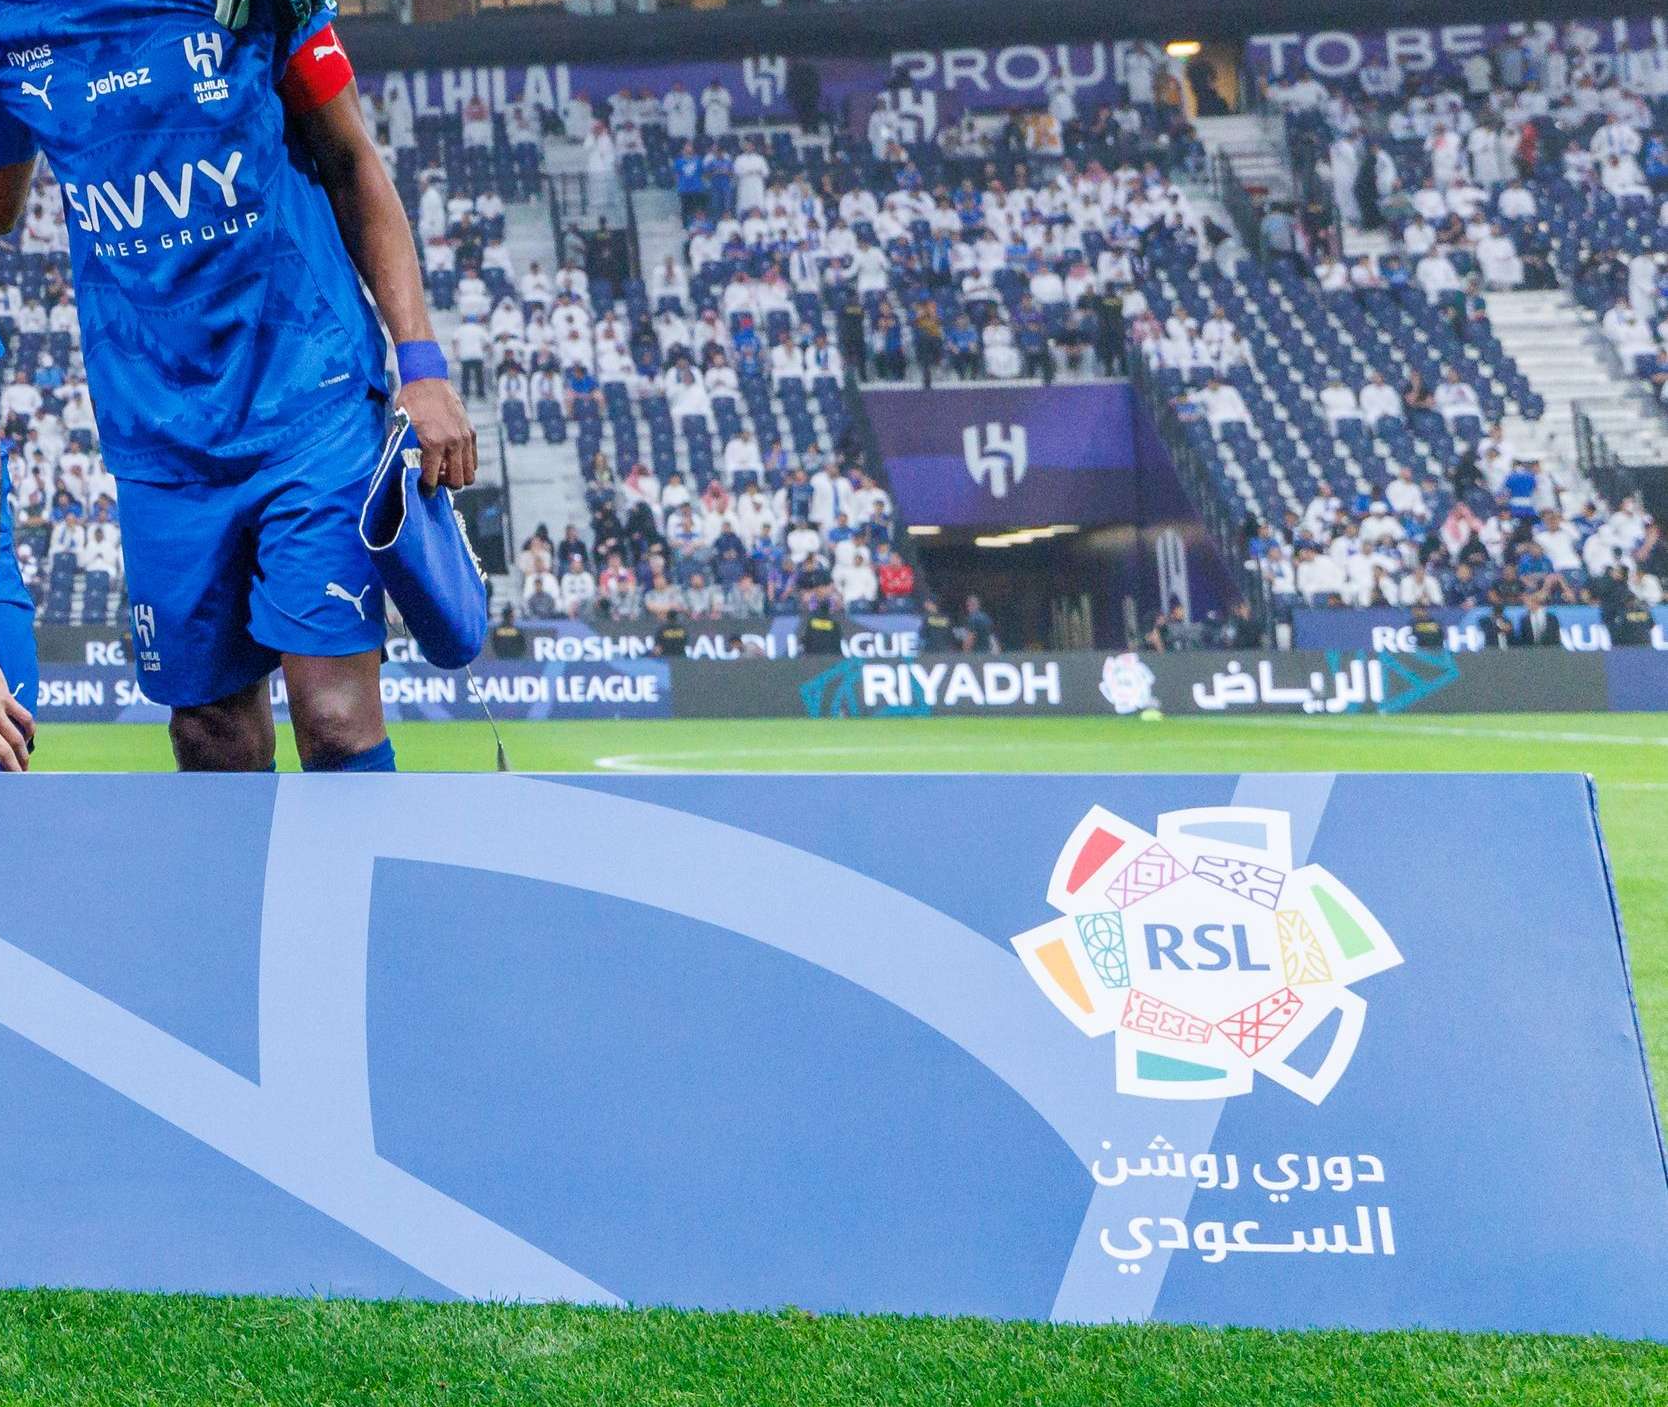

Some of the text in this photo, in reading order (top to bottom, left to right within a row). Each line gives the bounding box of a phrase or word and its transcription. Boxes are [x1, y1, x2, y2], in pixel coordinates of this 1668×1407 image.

[1250, 31, 1362, 77] TO
[67, 150, 243, 234] SAVVY
[94, 211, 259, 257] AMES GROUP
[37, 680, 104, 706] OSHN
[380, 675, 660, 704] OSHN SAUDI LEAGUE
[864, 662, 1061, 707] RIYADH
[1192, 659, 1384, 714] الرياض
[1143, 923, 1271, 972] RSL
[1091, 1134, 1386, 1203] دوري روشن
[1099, 1205, 1396, 1275] السعودي
